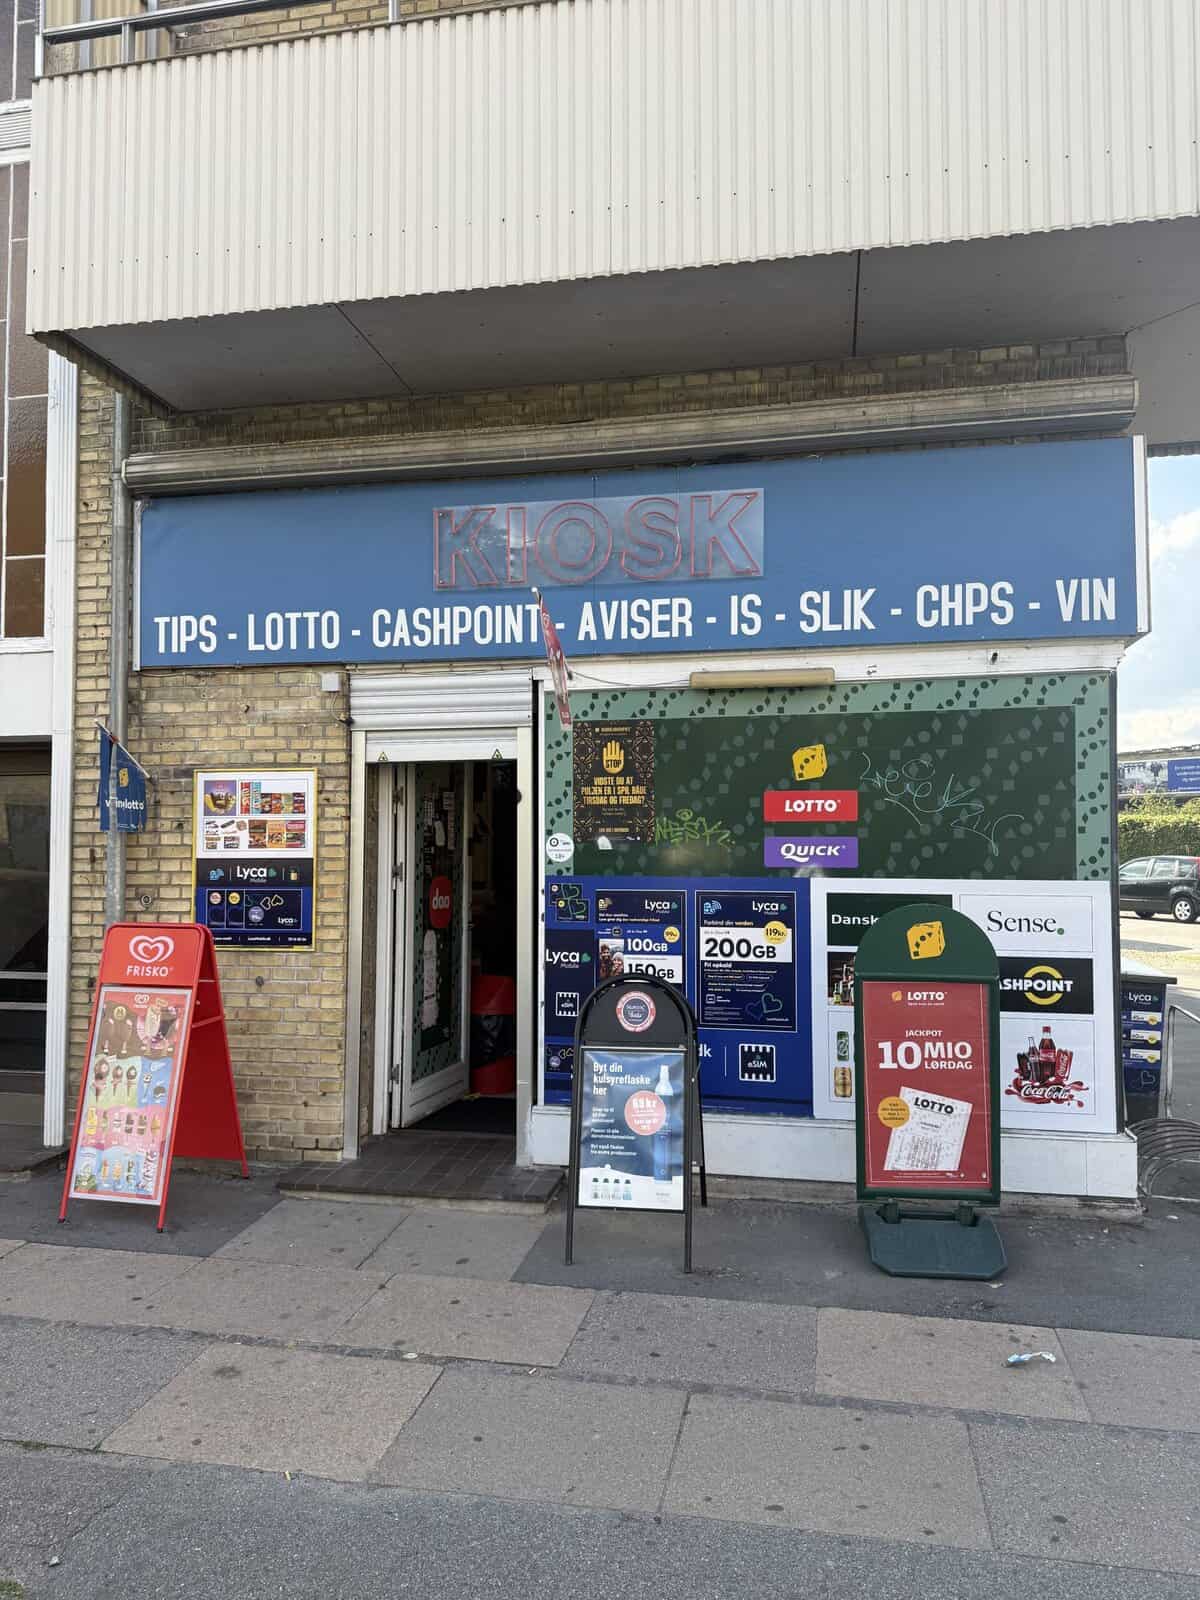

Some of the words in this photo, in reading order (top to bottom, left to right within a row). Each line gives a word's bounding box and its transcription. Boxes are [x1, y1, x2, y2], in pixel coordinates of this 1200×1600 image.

[434, 489, 761, 589] KIOSK
[153, 614, 218, 654] TIPS
[247, 610, 341, 650] LOTTO
[372, 603, 542, 648] CASHPOINT
[577, 597, 693, 641] AVISER
[730, 593, 763, 636] IS
[799, 588, 876, 632] SLIK
[915, 581, 1015, 628] CHPS
[1055, 576, 1116, 622] VIN
[605, 759, 622, 769] STOP
[784, 799, 838, 813] LOTTO
[780, 843, 841, 863] QUICK
[236, 865, 267, 880] Lyca
[645, 899, 670, 911] Lyca
[752, 900, 779, 914] Lyca
[277, 917, 294, 925] Lyca
[626, 938, 669, 952] 100GB
[704, 938, 777, 959] 200GB
[545, 949, 580, 965] Lyca
[126, 965, 169, 978] FRISKO
[907, 991, 945, 1001] LOTTO
[1128, 991, 1152, 1002] Lyca
[905, 1029, 943, 1038] JACKPOT
[877, 1040, 922, 1070] 10
[923, 1041, 972, 1059] MIO
[609, 1062, 623, 1073] din
[747, 1060, 767, 1069] eSIM
[924, 1060, 973, 1070] LØRDAG
[593, 1085, 608, 1096] her
[914, 1097, 954, 1115] LOTTO
